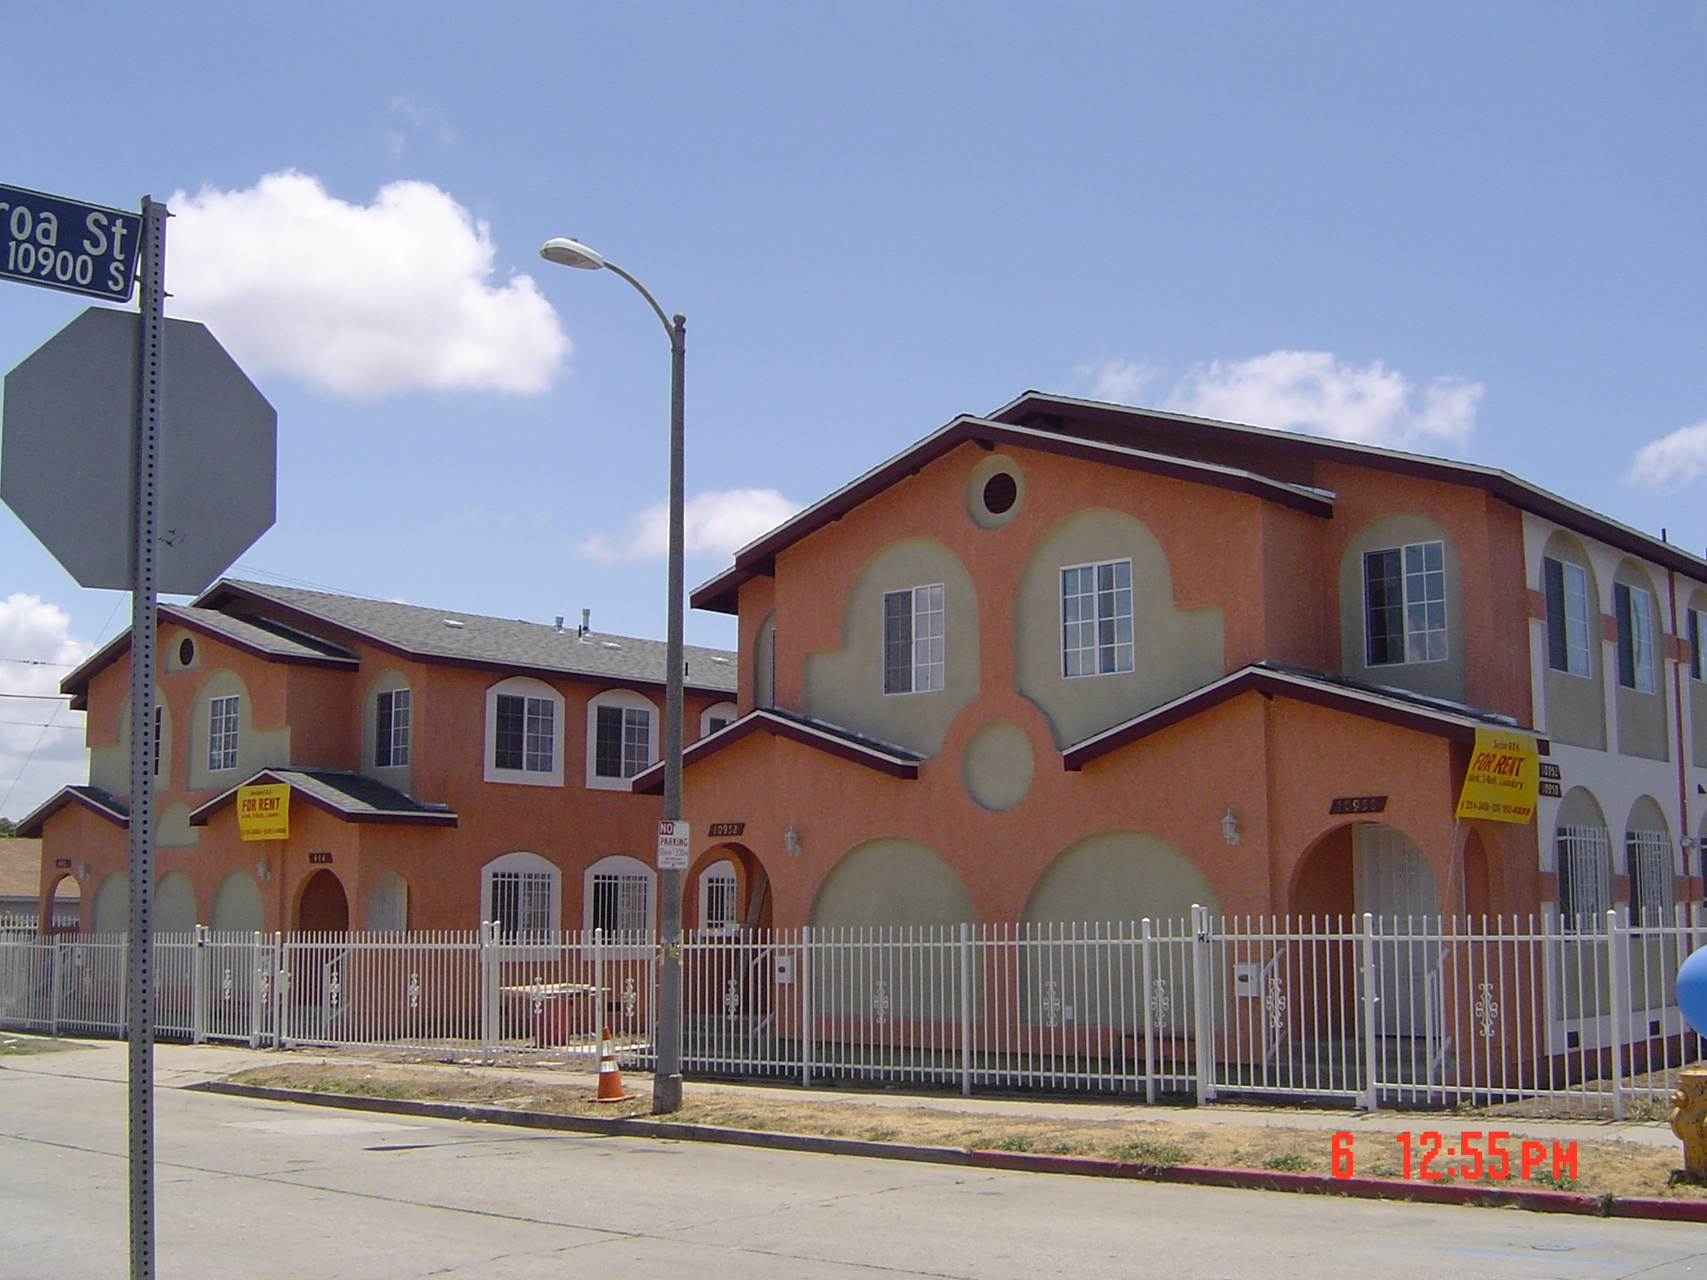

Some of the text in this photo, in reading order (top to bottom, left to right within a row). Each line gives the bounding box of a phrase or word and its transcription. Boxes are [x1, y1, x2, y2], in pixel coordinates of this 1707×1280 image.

[83, 211, 128, 261] St
[8, 240, 125, 292] 10900 S
[1471, 752, 1525, 777] FOR RENT
[242, 797, 281, 813] FOR RENT
[660, 822, 673, 834] NO
[713, 824, 738, 835] 10952
[660, 837, 688, 847] PARKING
